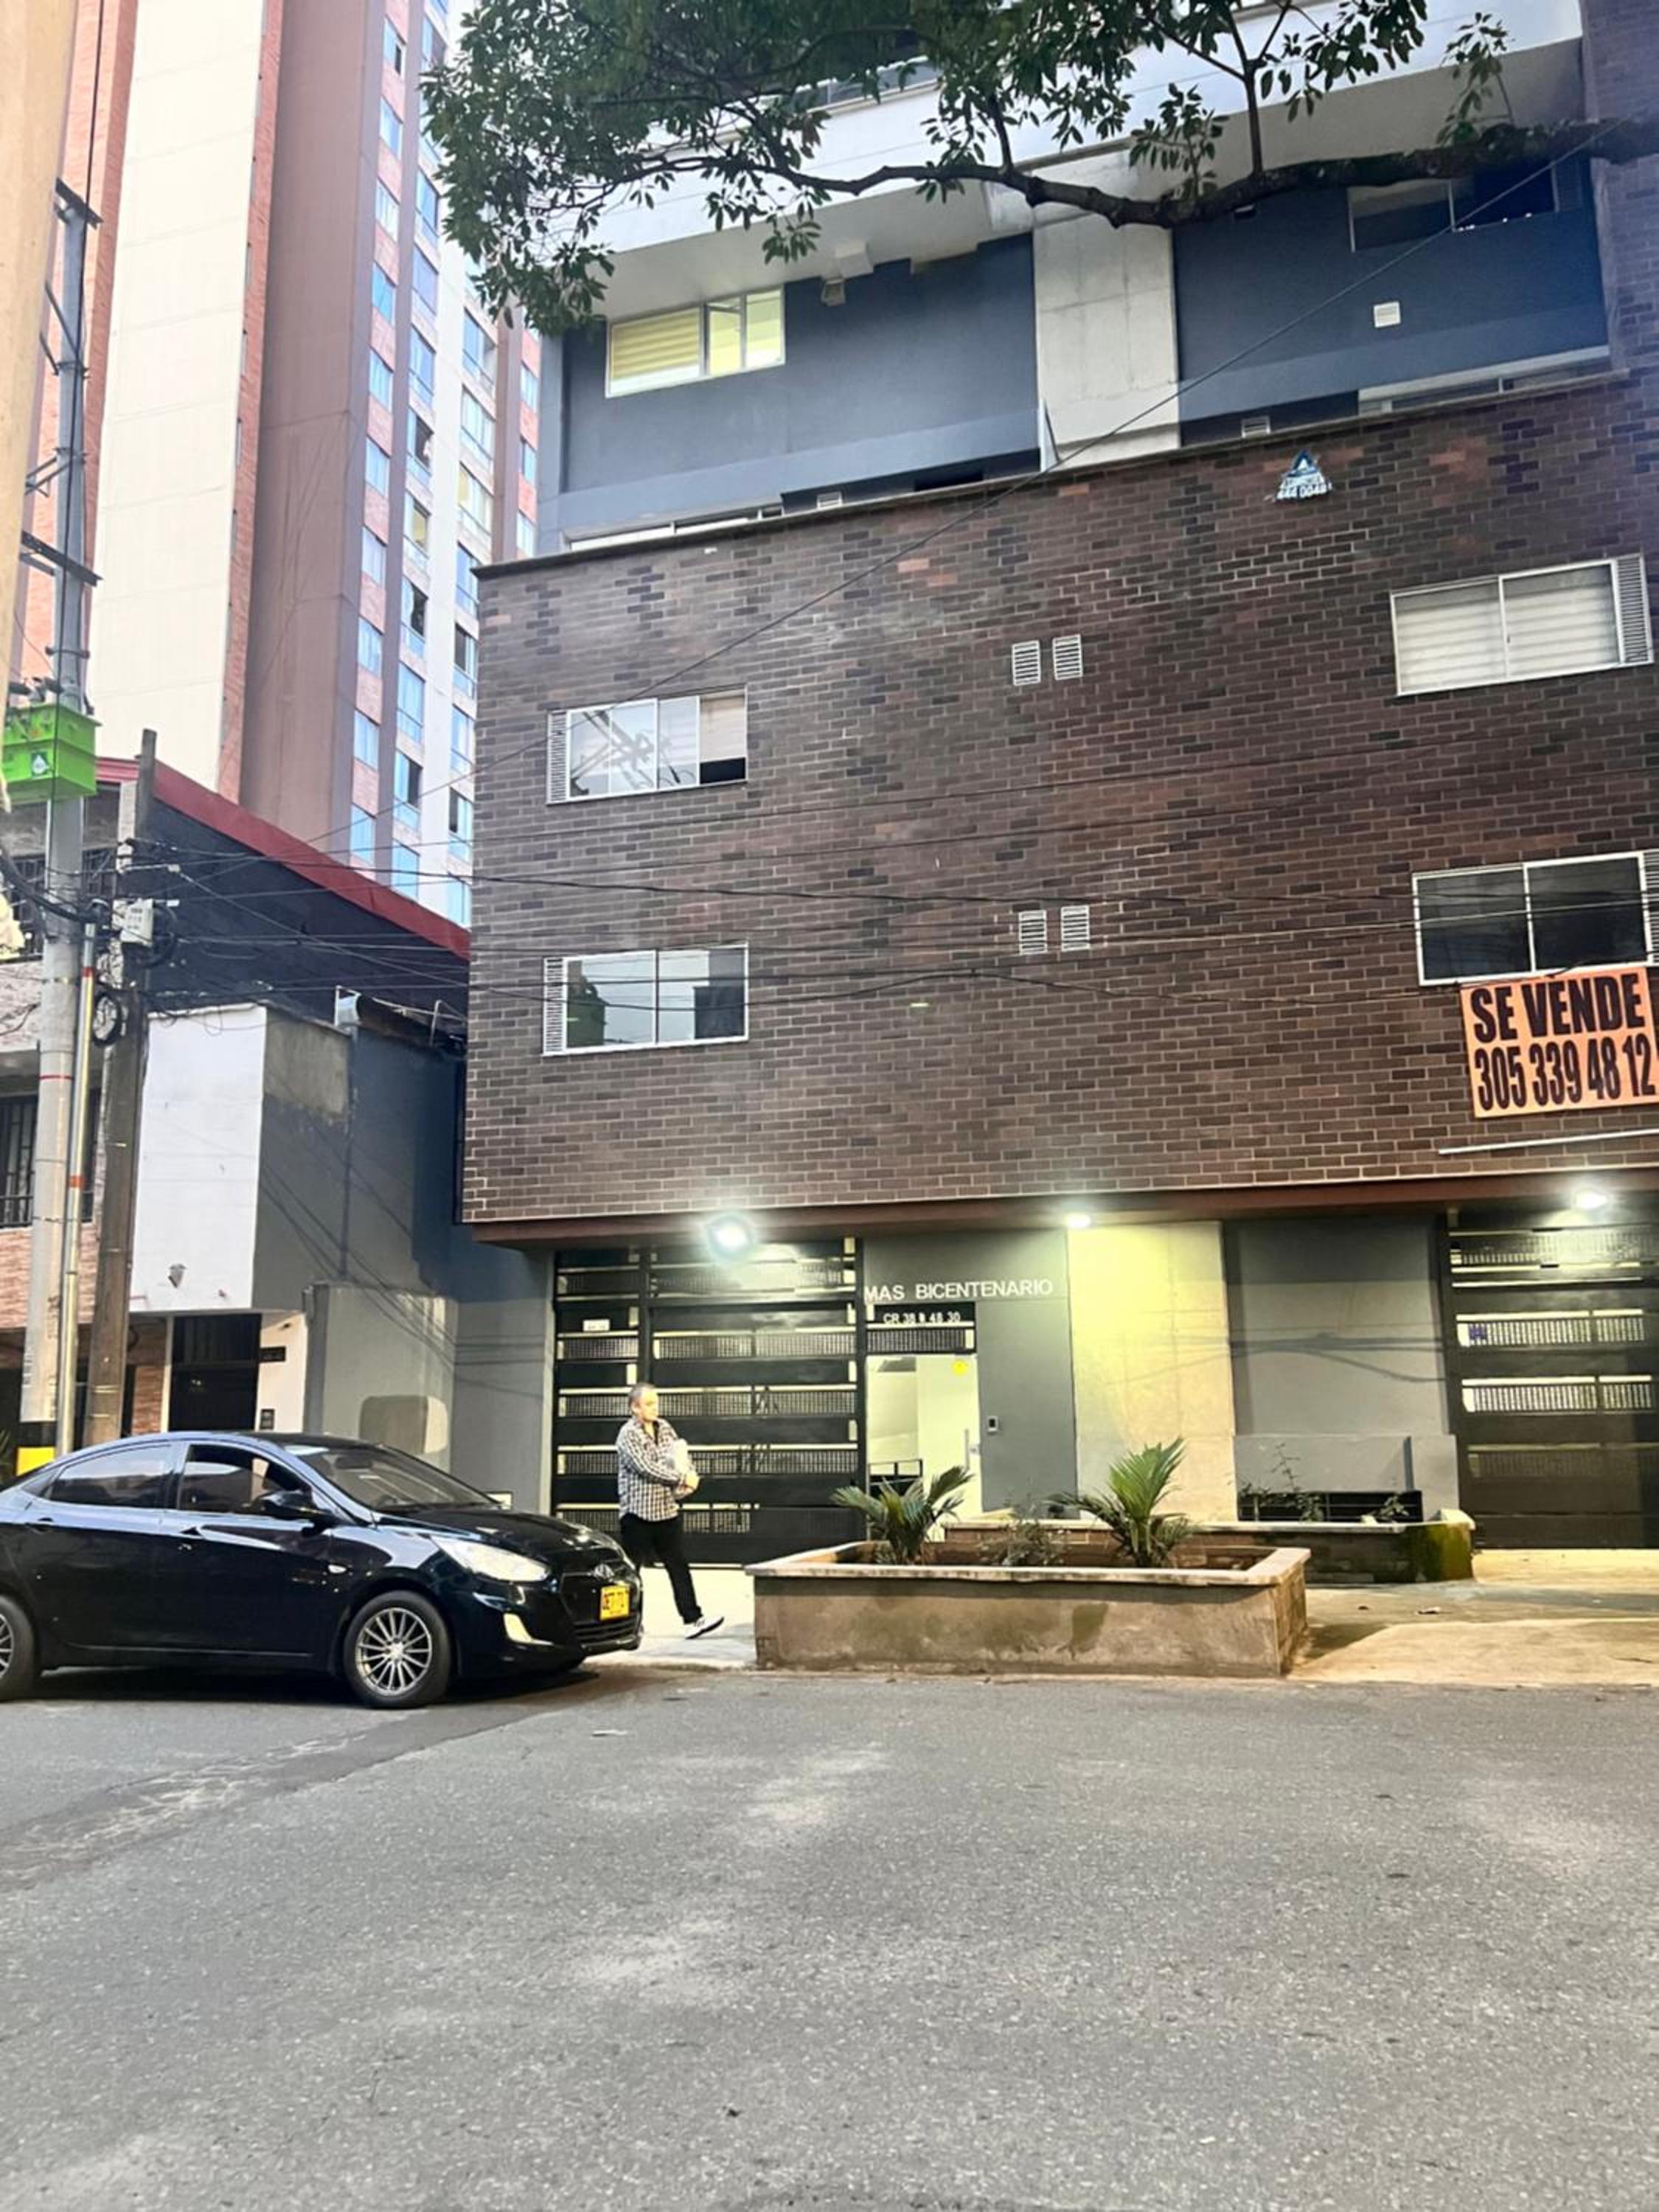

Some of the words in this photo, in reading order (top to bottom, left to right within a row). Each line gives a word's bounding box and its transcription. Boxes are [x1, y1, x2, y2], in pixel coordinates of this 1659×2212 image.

[1470, 986, 1517, 1043] SE
[1521, 973, 1645, 1037] VENDE
[1475, 1046, 1527, 1110] 305
[1529, 1040, 1582, 1106] 339
[1587, 1037, 1621, 1099] 48
[1623, 1033, 1655, 1096] 12
[916, 1279, 1053, 1299] BICENTENARIO
